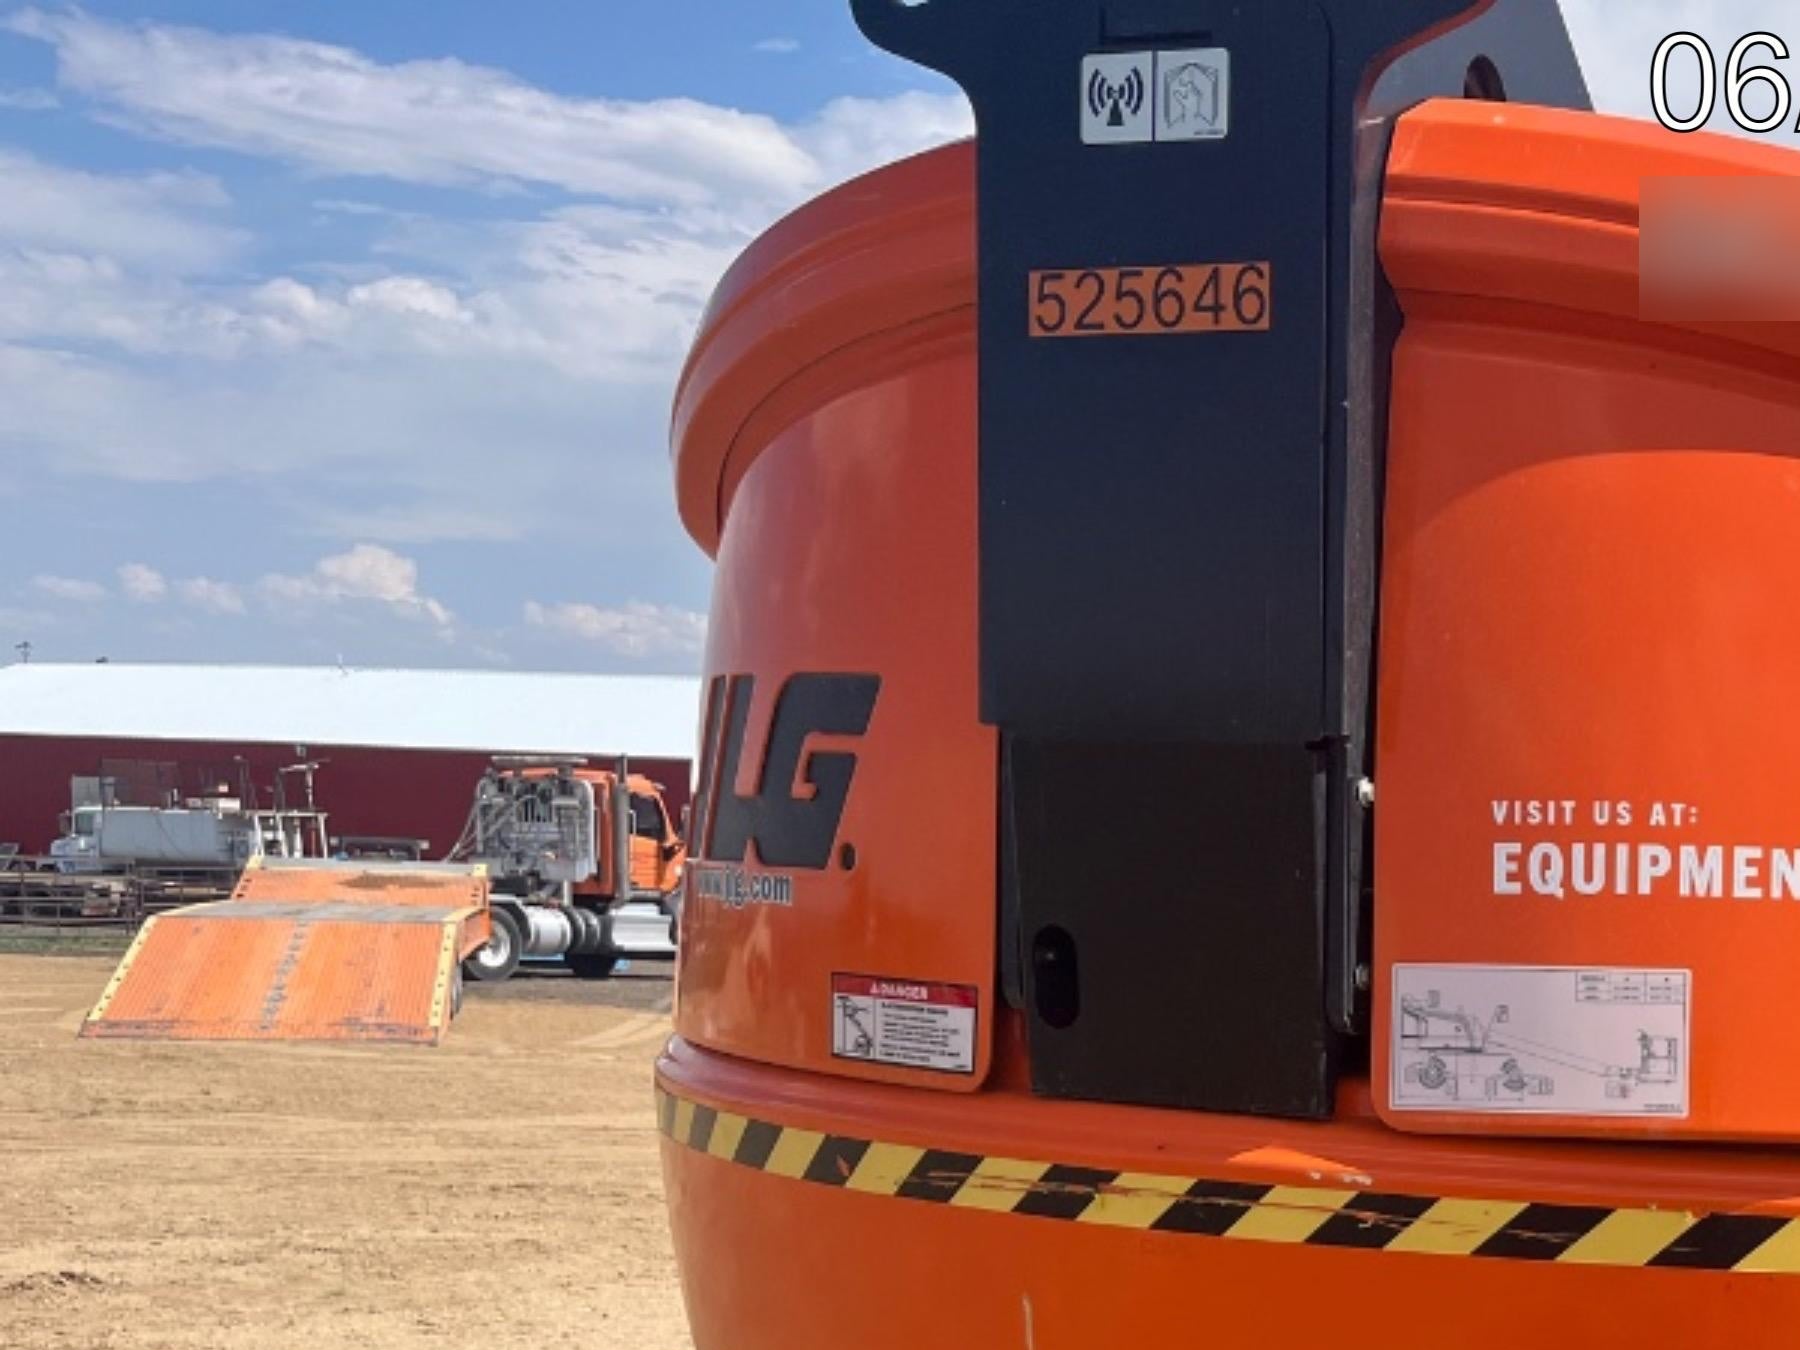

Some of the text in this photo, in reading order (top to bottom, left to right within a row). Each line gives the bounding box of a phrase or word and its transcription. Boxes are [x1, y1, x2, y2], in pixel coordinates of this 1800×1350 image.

[1034, 264, 1266, 332] 525646
[1493, 800, 1699, 827] VISIT US AT:
